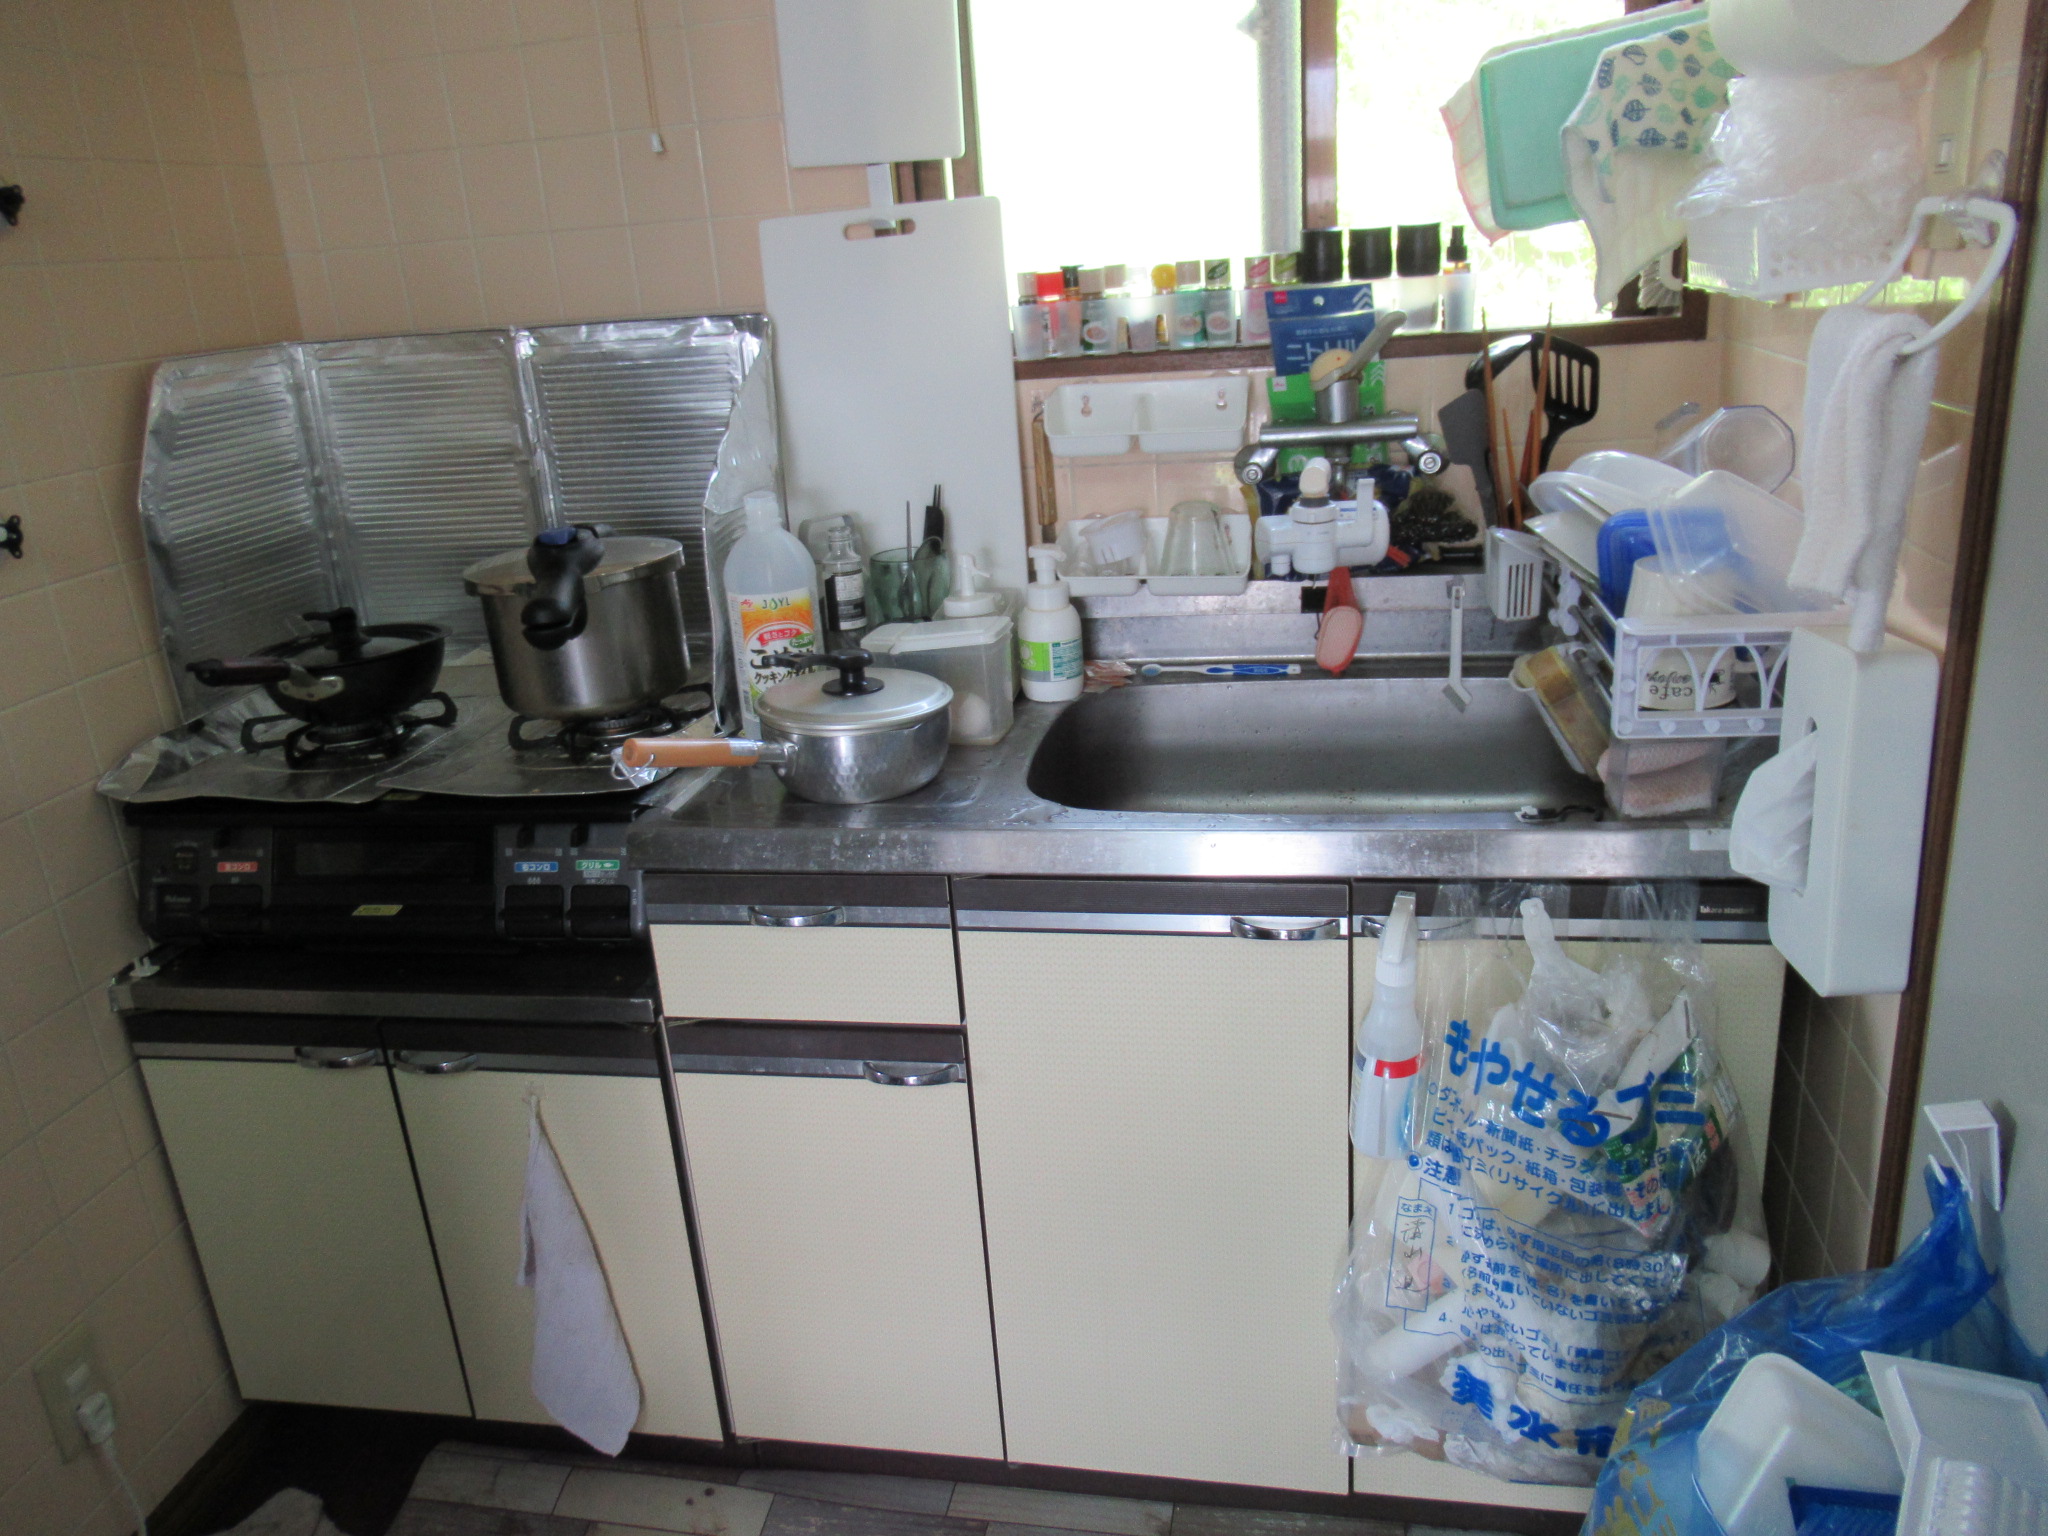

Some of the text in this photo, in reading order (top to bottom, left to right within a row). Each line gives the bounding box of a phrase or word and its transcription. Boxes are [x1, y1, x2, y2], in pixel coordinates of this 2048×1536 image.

[761, 597, 791, 610] JOYL
[1649, 685, 1693, 701] cafe
[581, 861, 602, 869] グリル
[1443, 1019, 1706, 1148] もやせるゴミ
[1423, 1158, 1462, 1187] 注意
[1400, 1203, 1433, 1217] なまえ
